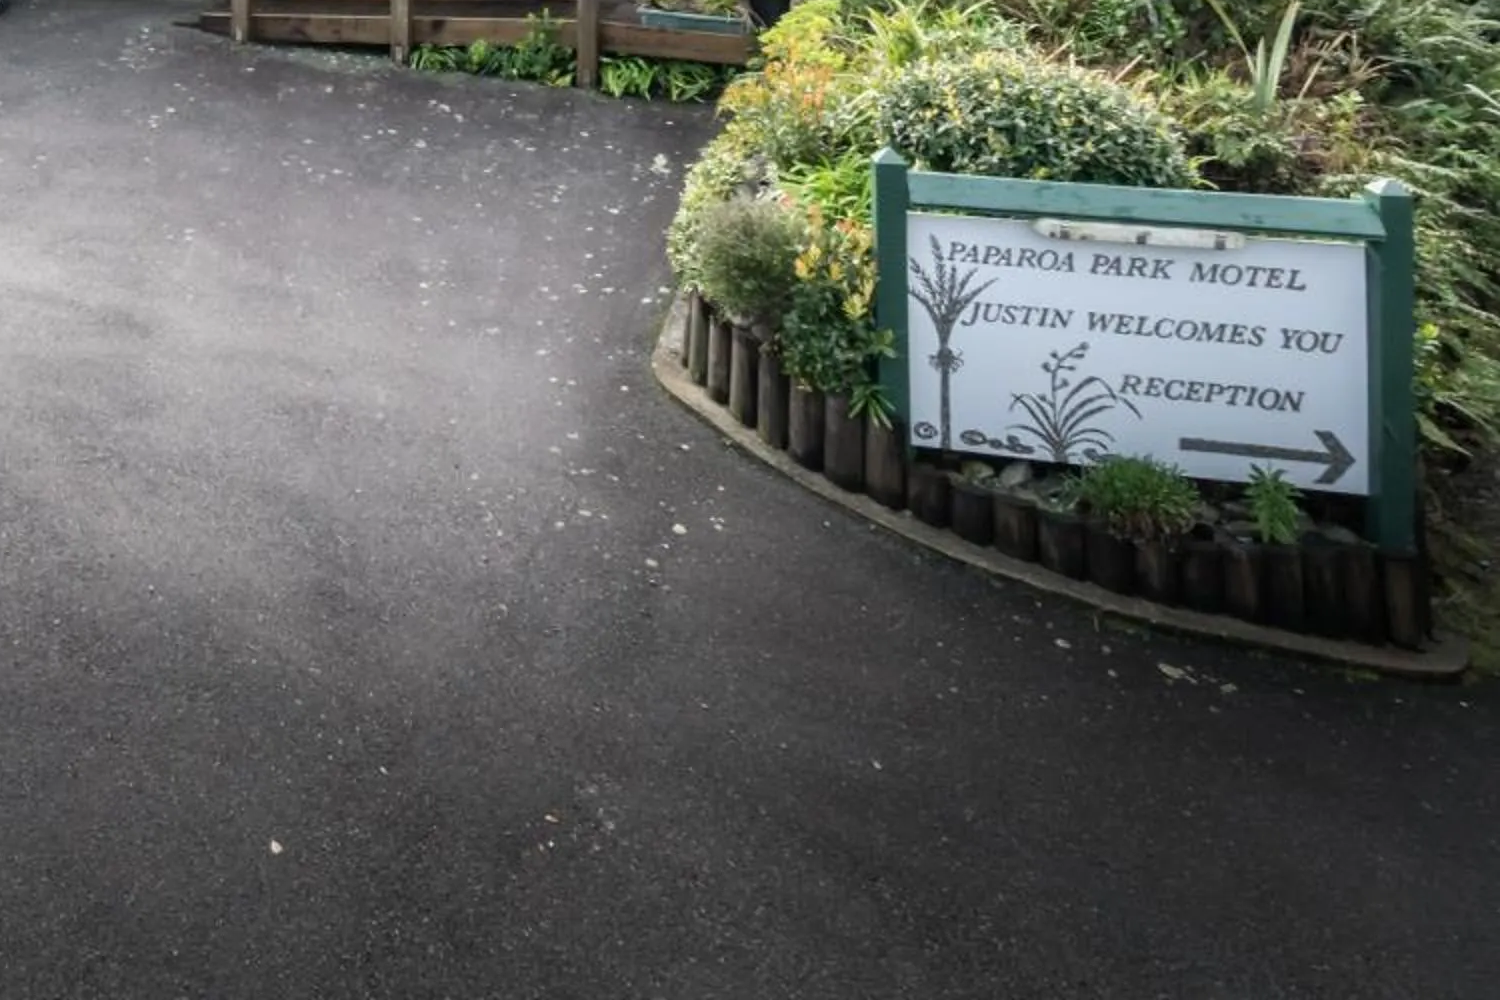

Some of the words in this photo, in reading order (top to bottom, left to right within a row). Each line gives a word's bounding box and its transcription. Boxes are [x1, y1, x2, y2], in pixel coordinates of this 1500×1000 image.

[948, 241, 1074, 273] PAPAROA
[1090, 253, 1175, 280] PARK
[1189, 262, 1307, 291] MOTEL
[961, 302, 1075, 329] JUSTIN
[1087, 311, 1266, 347] WELCOMES
[1280, 328, 1343, 354] YOU
[1119, 374, 1305, 412] RECEPTION
